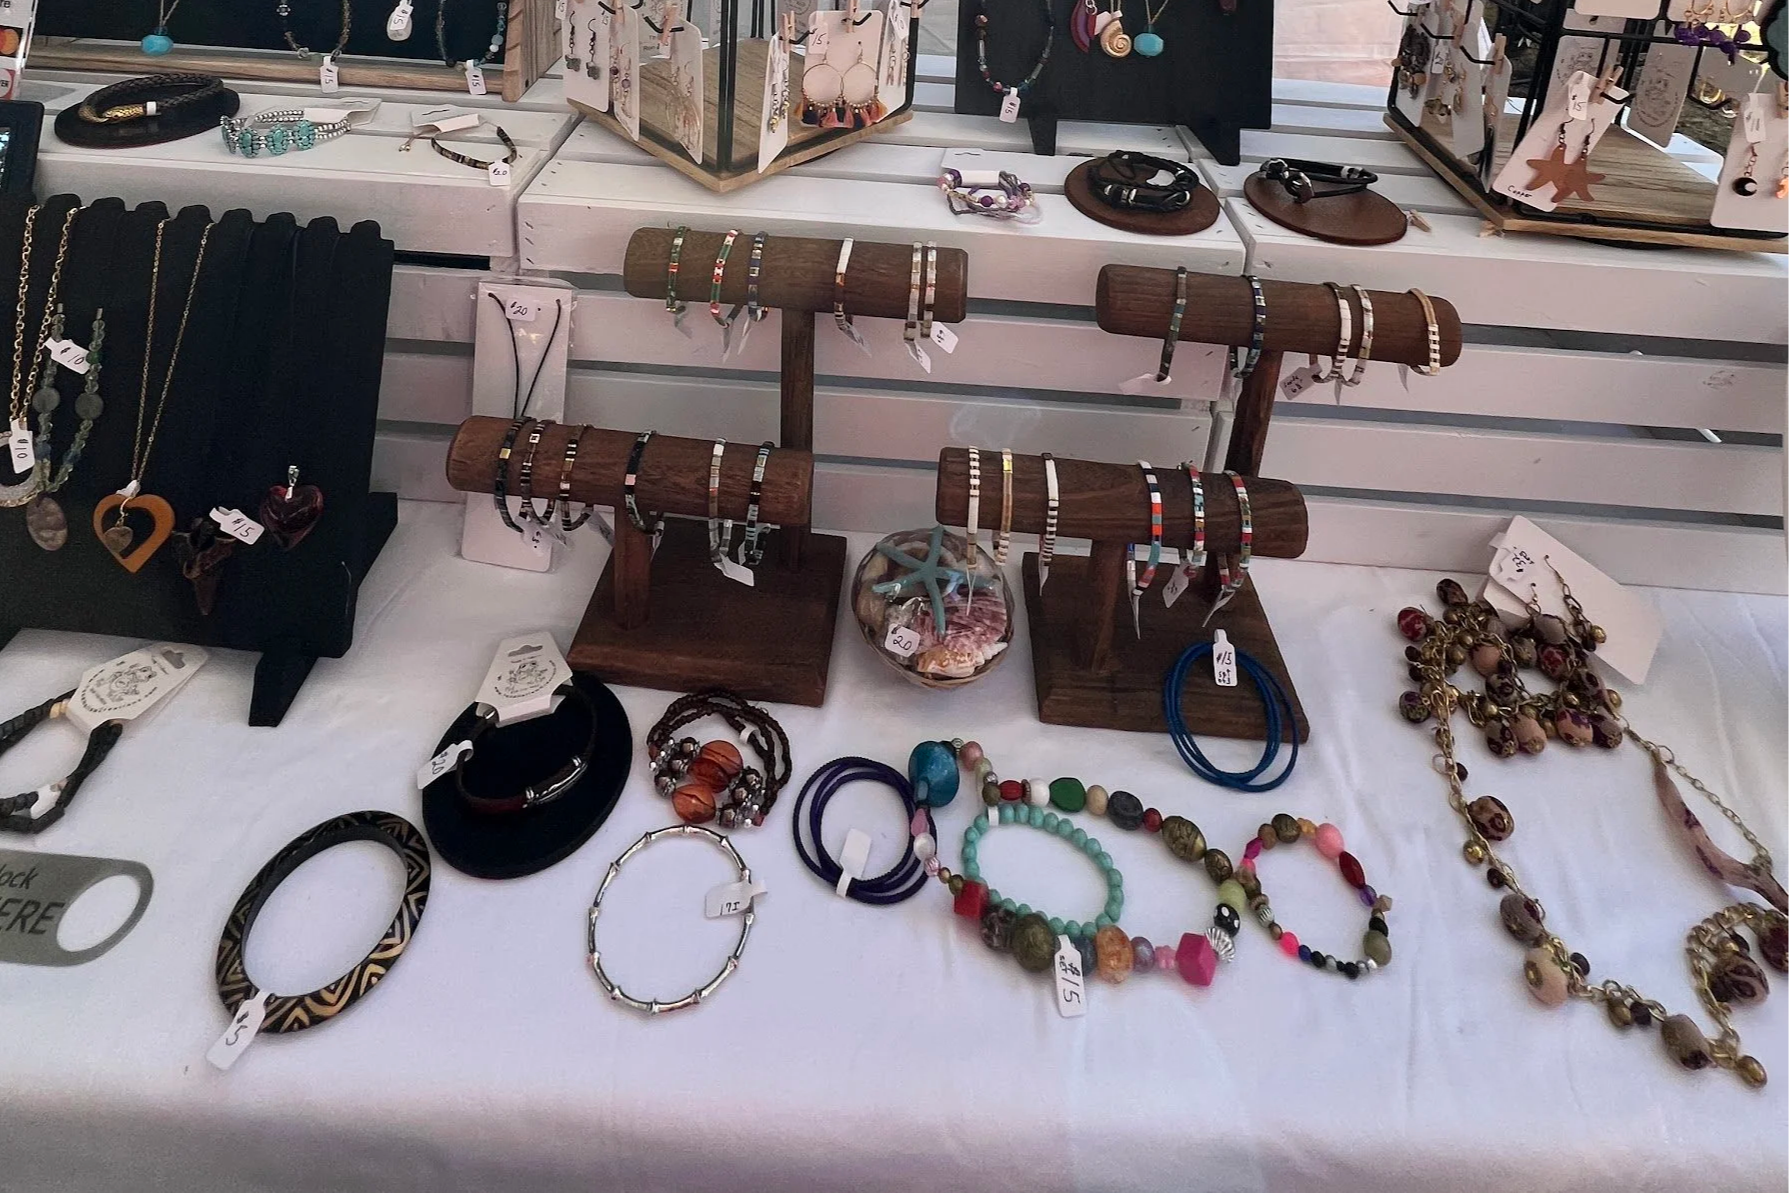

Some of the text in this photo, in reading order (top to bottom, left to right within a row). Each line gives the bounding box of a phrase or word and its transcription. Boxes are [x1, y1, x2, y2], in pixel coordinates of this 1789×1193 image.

[392, 8, 409, 26] $15
[325, 67, 334, 86] $15
[471, 73, 481, 88] $15
[1004, 101, 1017, 115] $15
[1570, 94, 1583, 112] $15
[510, 300, 528, 316] $20
[59, 346, 86, 366] $10
[14, 438, 29, 459] $10
[231, 517, 256, 538] $15
[890, 624, 913, 651] $20
[1215, 650, 1233, 666] $15
[431, 751, 448, 775] $20
[1060, 962, 1082, 1005] $15
[225, 1010, 250, 1046] $5
